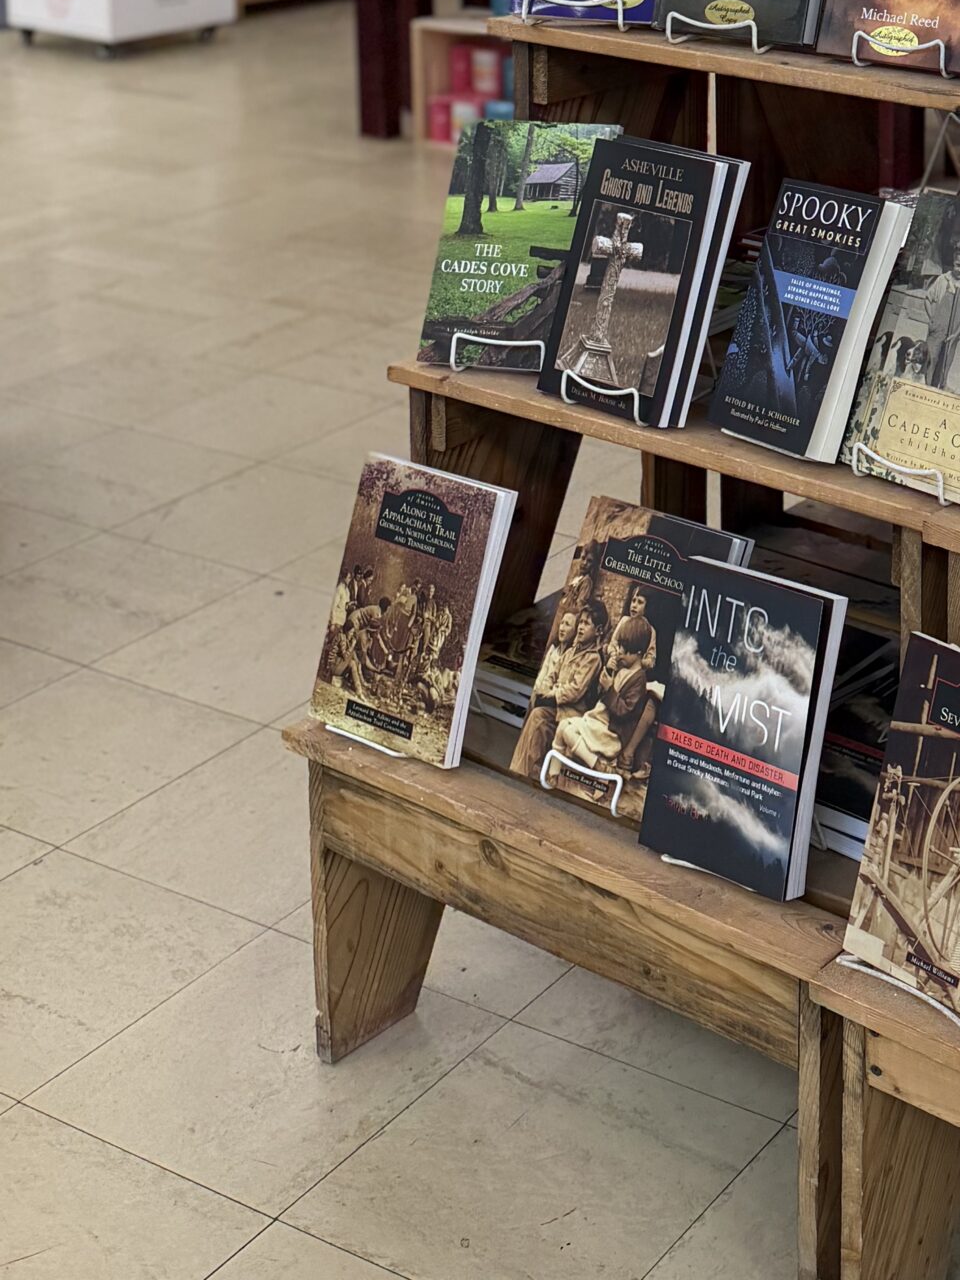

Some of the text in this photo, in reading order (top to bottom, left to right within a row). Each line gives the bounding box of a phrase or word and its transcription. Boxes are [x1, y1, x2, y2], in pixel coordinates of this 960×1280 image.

[621, 159, 684, 182] ASHEVILLE
[600, 168, 693, 214] GHOSTS AND LEGENDS
[779, 192, 872, 231] SPOOKY
[776, 220, 861, 247] GREAT SMOKIES
[474, 244, 502, 258] THE
[441, 259, 529, 278] CADES COVE
[460, 279, 504, 293] STORY
[888, 414, 940, 441] CADES
[382, 509, 456, 540] APPALACHIAN TRAIL
[400, 502, 443, 524] ALONG THE
[605, 556, 651, 580] GREENBRIER
[628, 549, 671, 572] THE LITTLE
[685, 583, 769, 654] INTO
[710, 647, 737, 672] the
[714, 684, 792, 753] MIST
[672, 732, 692, 746] TALES
[695, 741, 703, 749] OF
[706, 745, 729, 760] DEATH
[731, 755, 746, 767] AND
[910, 955, 956, 984] Michael Williams
